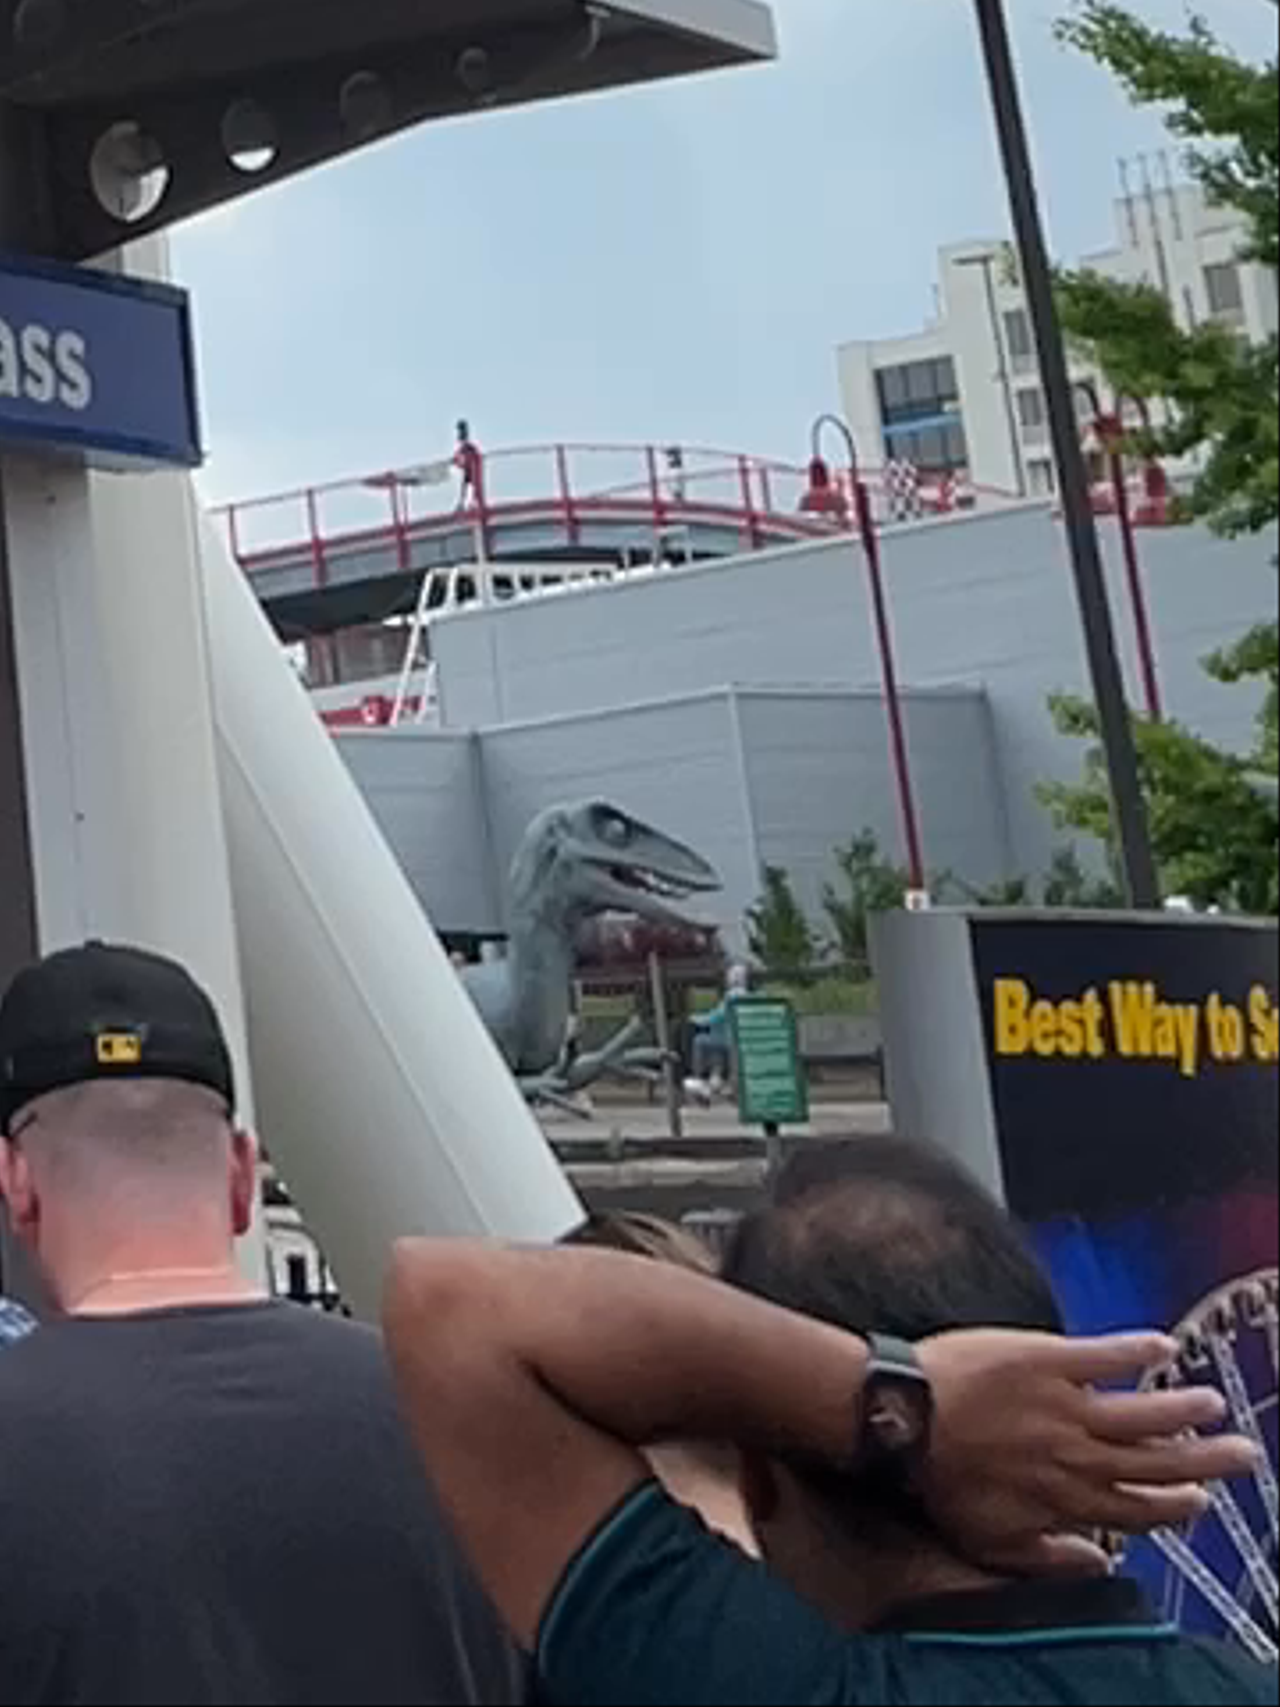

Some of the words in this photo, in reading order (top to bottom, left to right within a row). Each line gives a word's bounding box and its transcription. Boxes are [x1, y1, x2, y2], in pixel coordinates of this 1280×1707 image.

[993, 978, 1105, 1056] Best
[1108, 980, 1199, 1076] Way
[1206, 990, 1244, 1060] to
